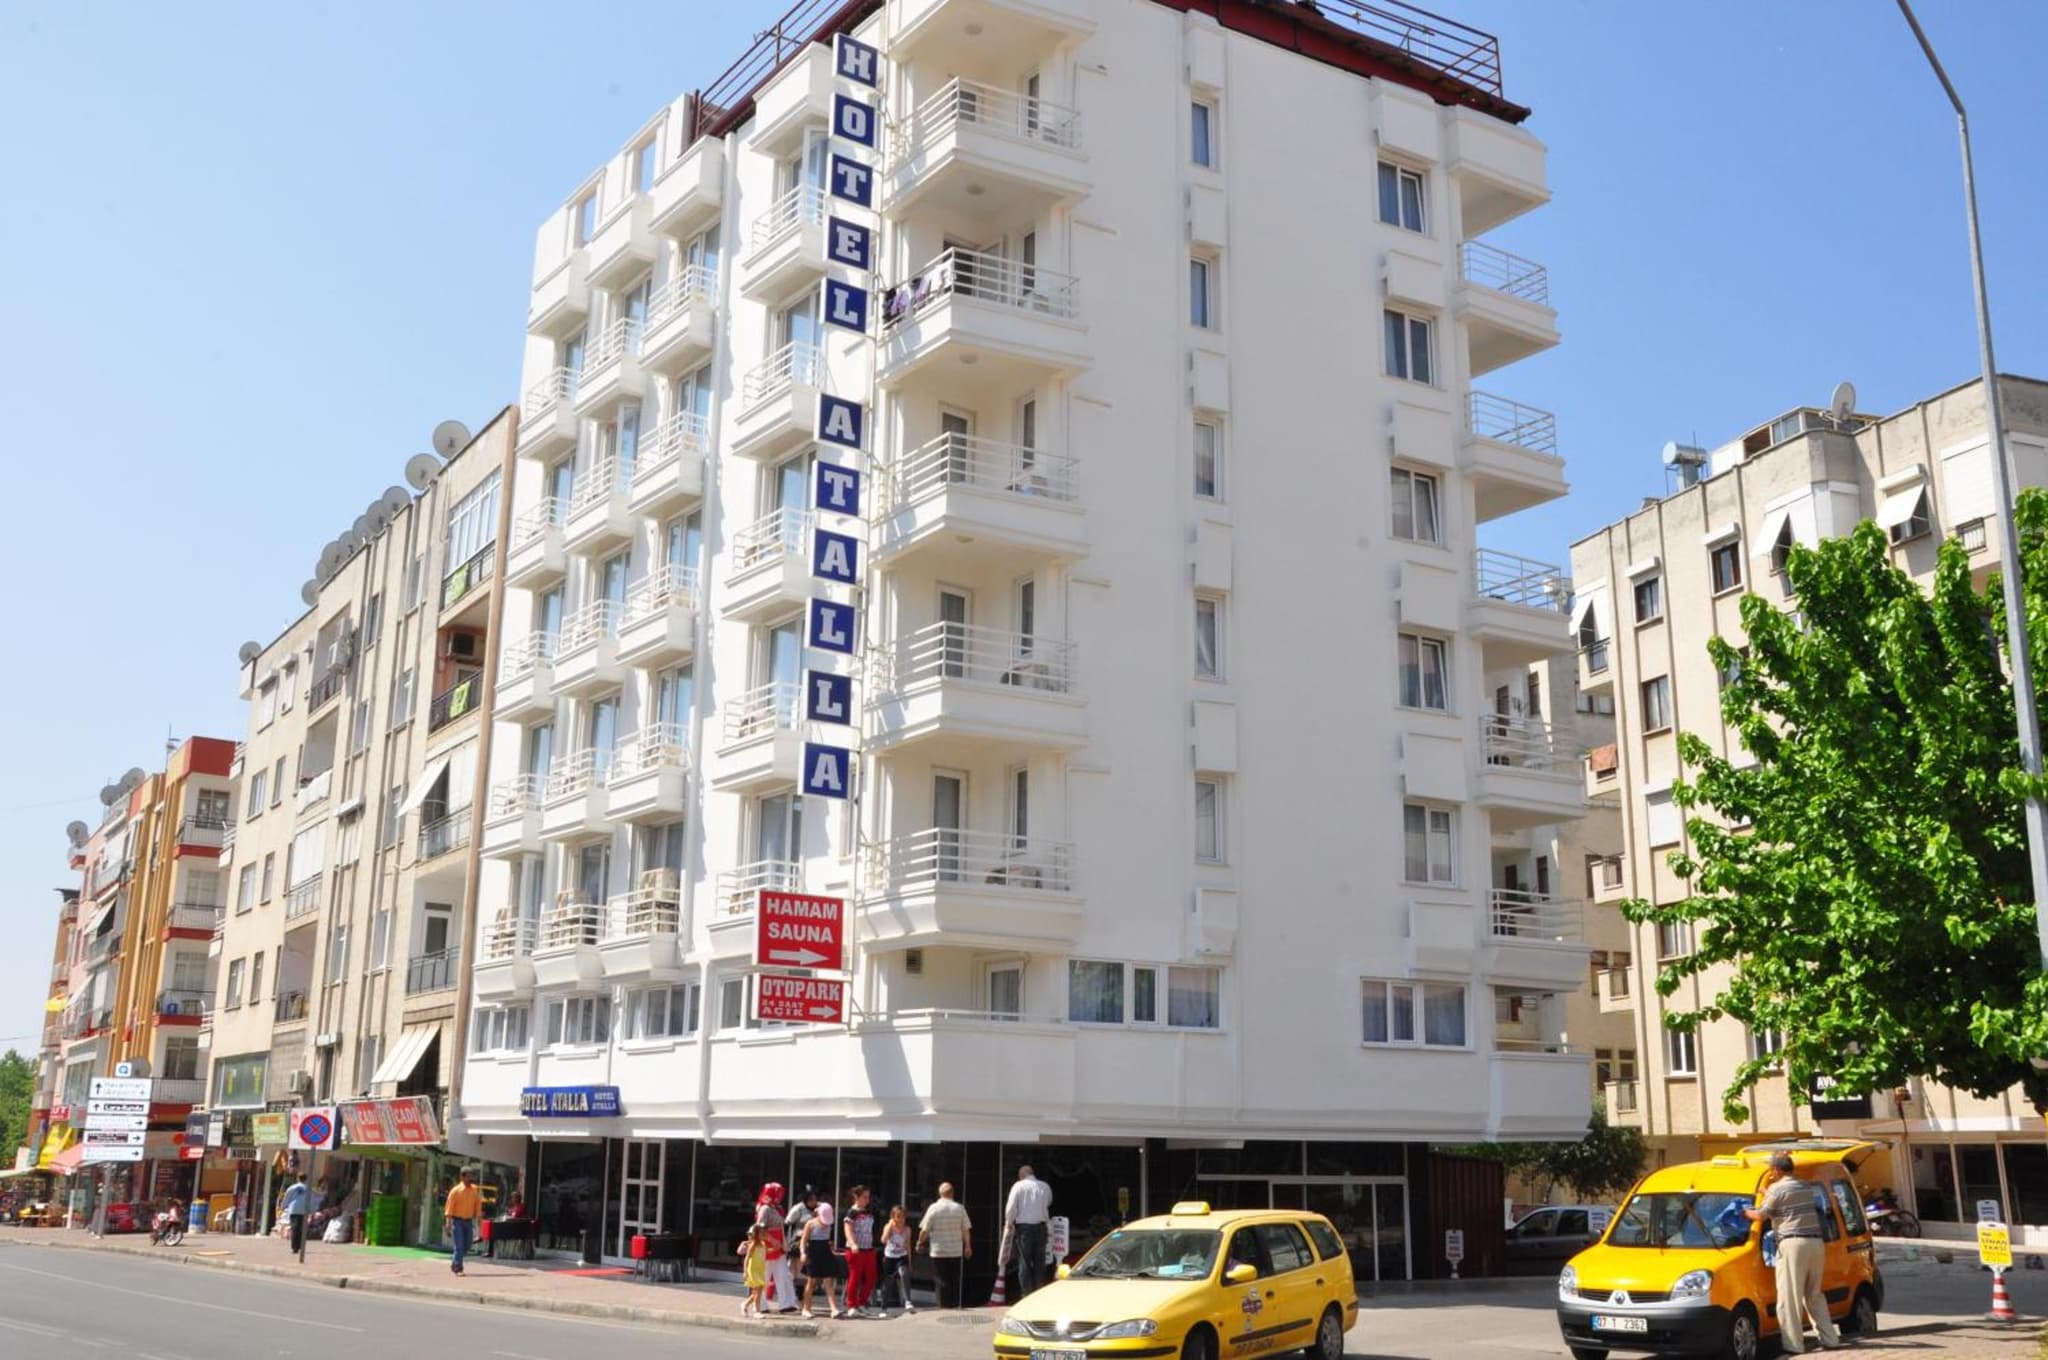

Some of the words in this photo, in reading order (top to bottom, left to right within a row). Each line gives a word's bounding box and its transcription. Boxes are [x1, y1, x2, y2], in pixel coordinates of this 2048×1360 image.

[832, 42, 871, 326] HOTEL
[810, 404, 855, 791] ATALLA
[766, 898, 838, 920] HAMAM
[768, 922, 834, 944] SAUNA
[762, 978, 840, 1001] OTOPARK
[520, 1092, 548, 1111] HOTEL
